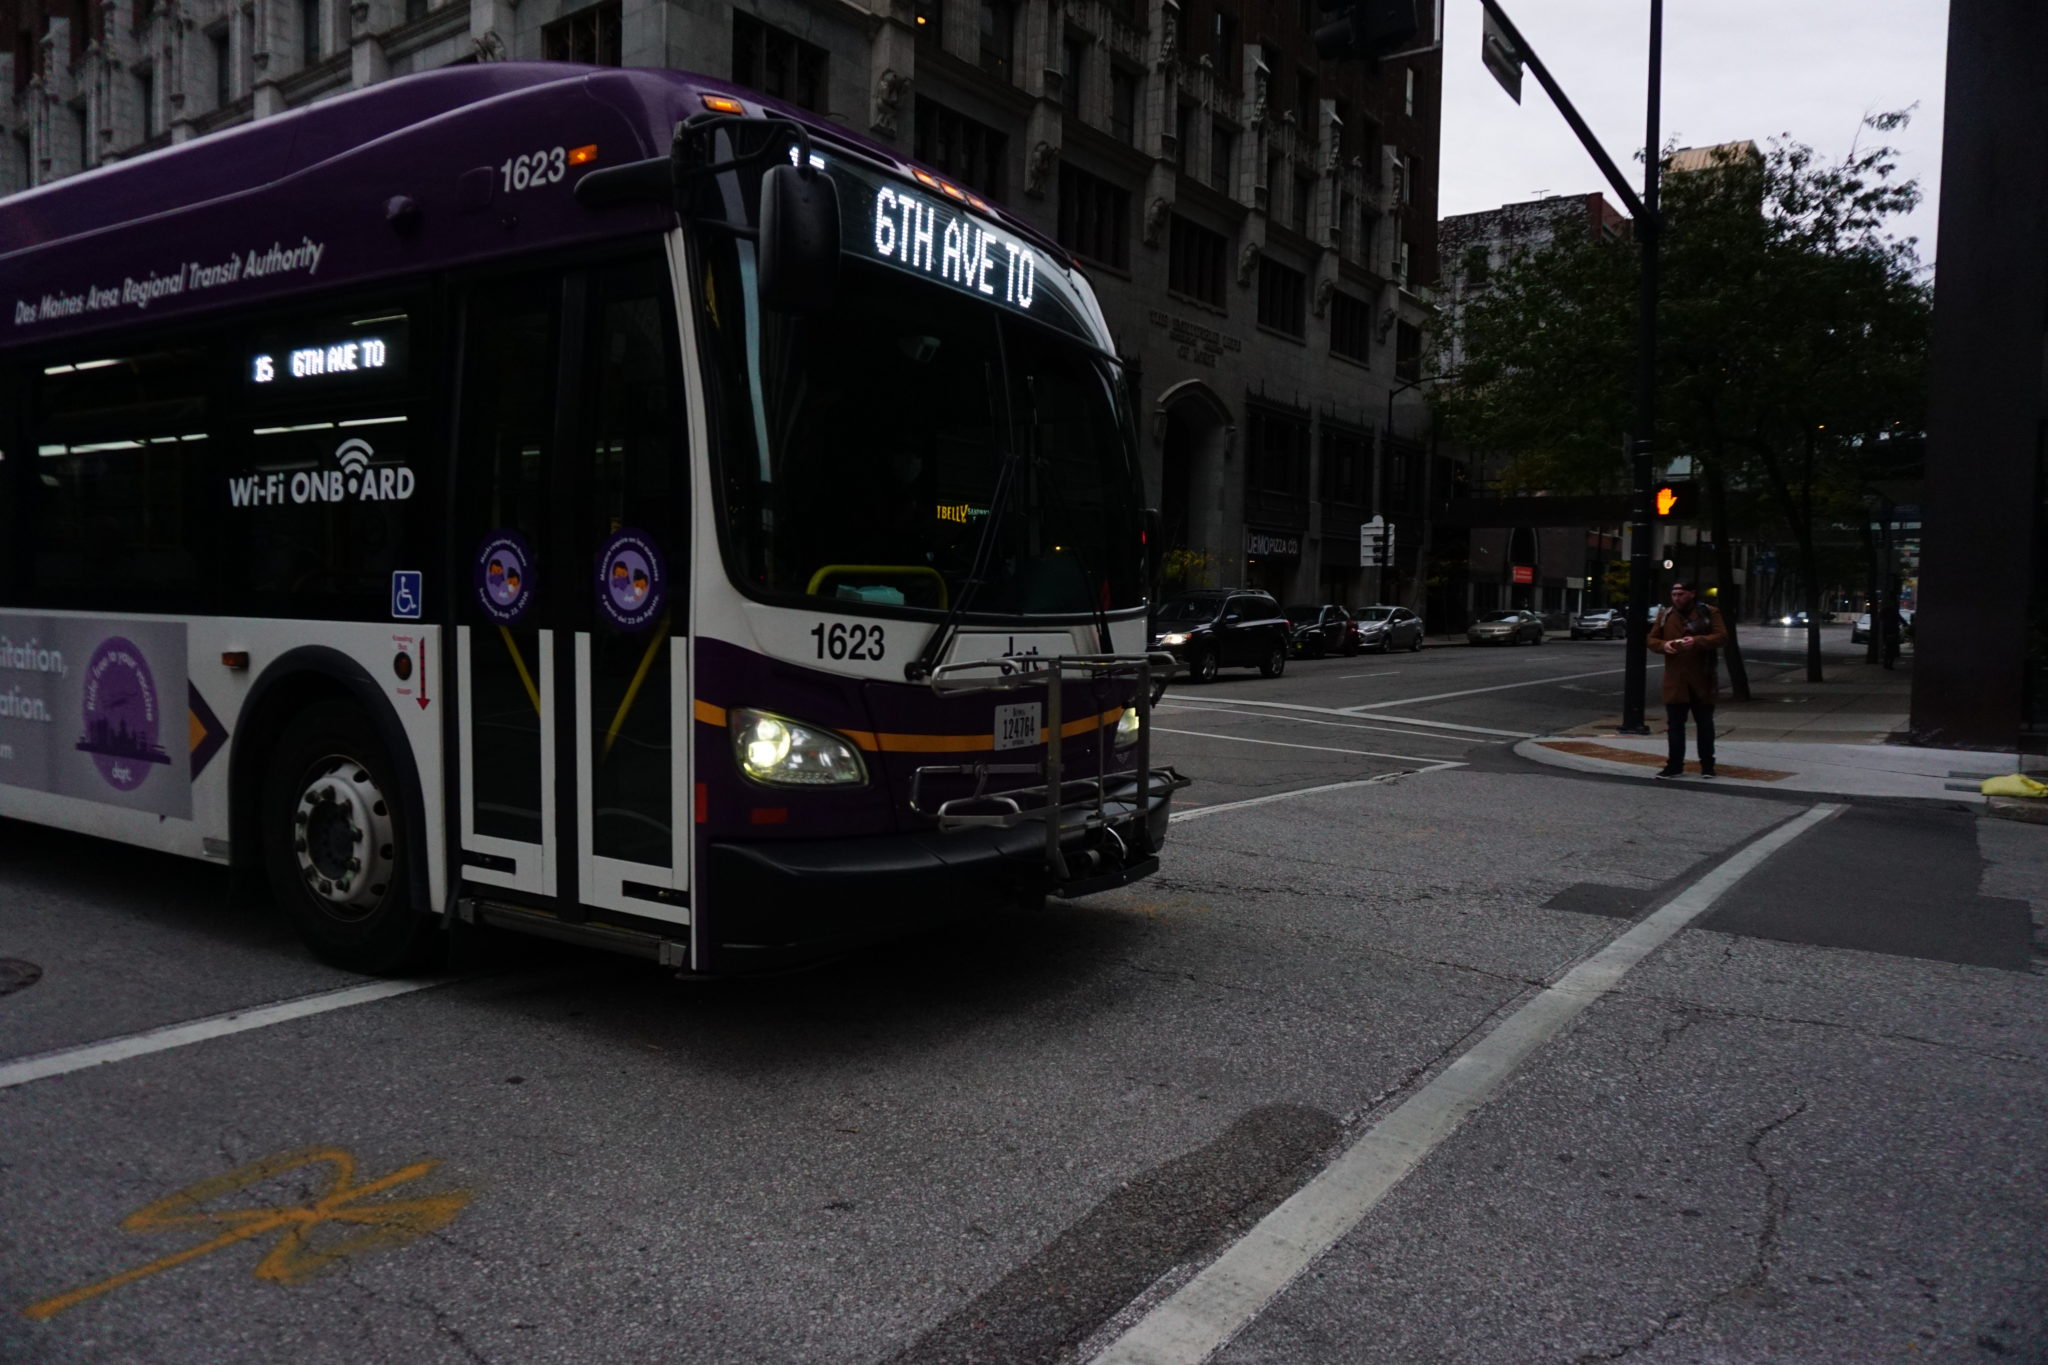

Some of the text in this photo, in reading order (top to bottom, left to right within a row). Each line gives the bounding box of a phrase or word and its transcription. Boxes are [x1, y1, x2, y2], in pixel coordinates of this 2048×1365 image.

[500, 145, 566, 193] 1623
[875, 186, 1035, 309] 6TH AVE TO
[14, 236, 325, 326] Des Moines Area Regional Transit Authority
[292, 348, 325, 378] 6TH
[327, 342, 359, 373] AVE
[362, 339, 386, 368] TO
[229, 472, 285, 508] Wi-Fi
[811, 623, 885, 661] 1623
[1004, 715, 1035, 740] 124764
